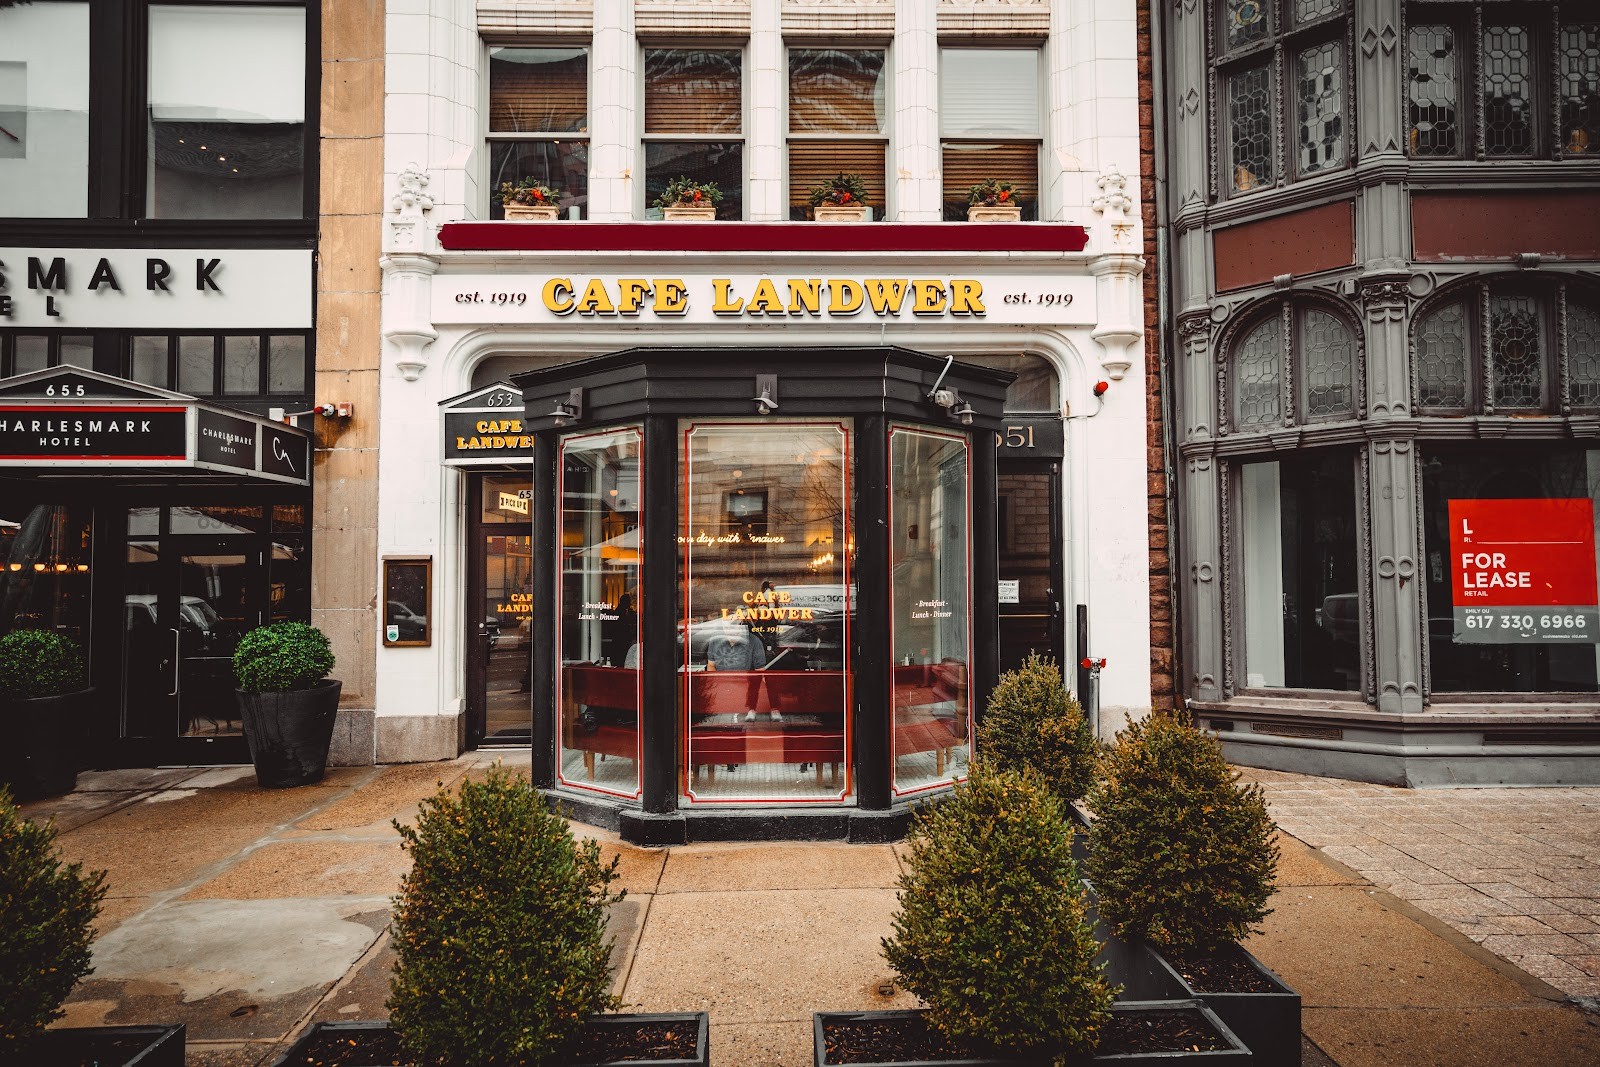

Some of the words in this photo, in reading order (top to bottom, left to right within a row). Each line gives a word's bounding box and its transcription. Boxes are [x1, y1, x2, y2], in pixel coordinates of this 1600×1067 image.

[0, 257, 221, 291] MARK
[455, 291, 484, 303] est.
[490, 291, 527, 305] 1919
[541, 277, 689, 315] CAFE
[711, 278, 986, 316] LANDWER
[1003, 292, 1032, 304] est.
[1037, 292, 1074, 306] 1919
[46, 384, 85, 396] 655
[487, 393, 513, 407] 653
[476, 420, 523, 434] CAFE
[39, 437, 91, 447] HOTEL
[456, 435, 534, 450] LANDWE
[220, 446, 236, 454] HOTEL
[519, 490, 532, 499] 65
[697, 531, 715, 547] day
[717, 532, 740, 543] with
[1461, 552, 1507, 569] FOR
[1463, 571, 1532, 588] LEASE
[511, 594, 533, 602] CAF
[742, 591, 791, 604] CAFE
[919, 600, 945, 608] Breakfast
[497, 604, 533, 612] LAND
[585, 602, 612, 610] Breakfast
[721, 608, 814, 621] LANDWER
[1465, 615, 1494, 629] 617
[1500, 615, 1534, 629] 330
[1540, 615, 1586, 629] 6966
